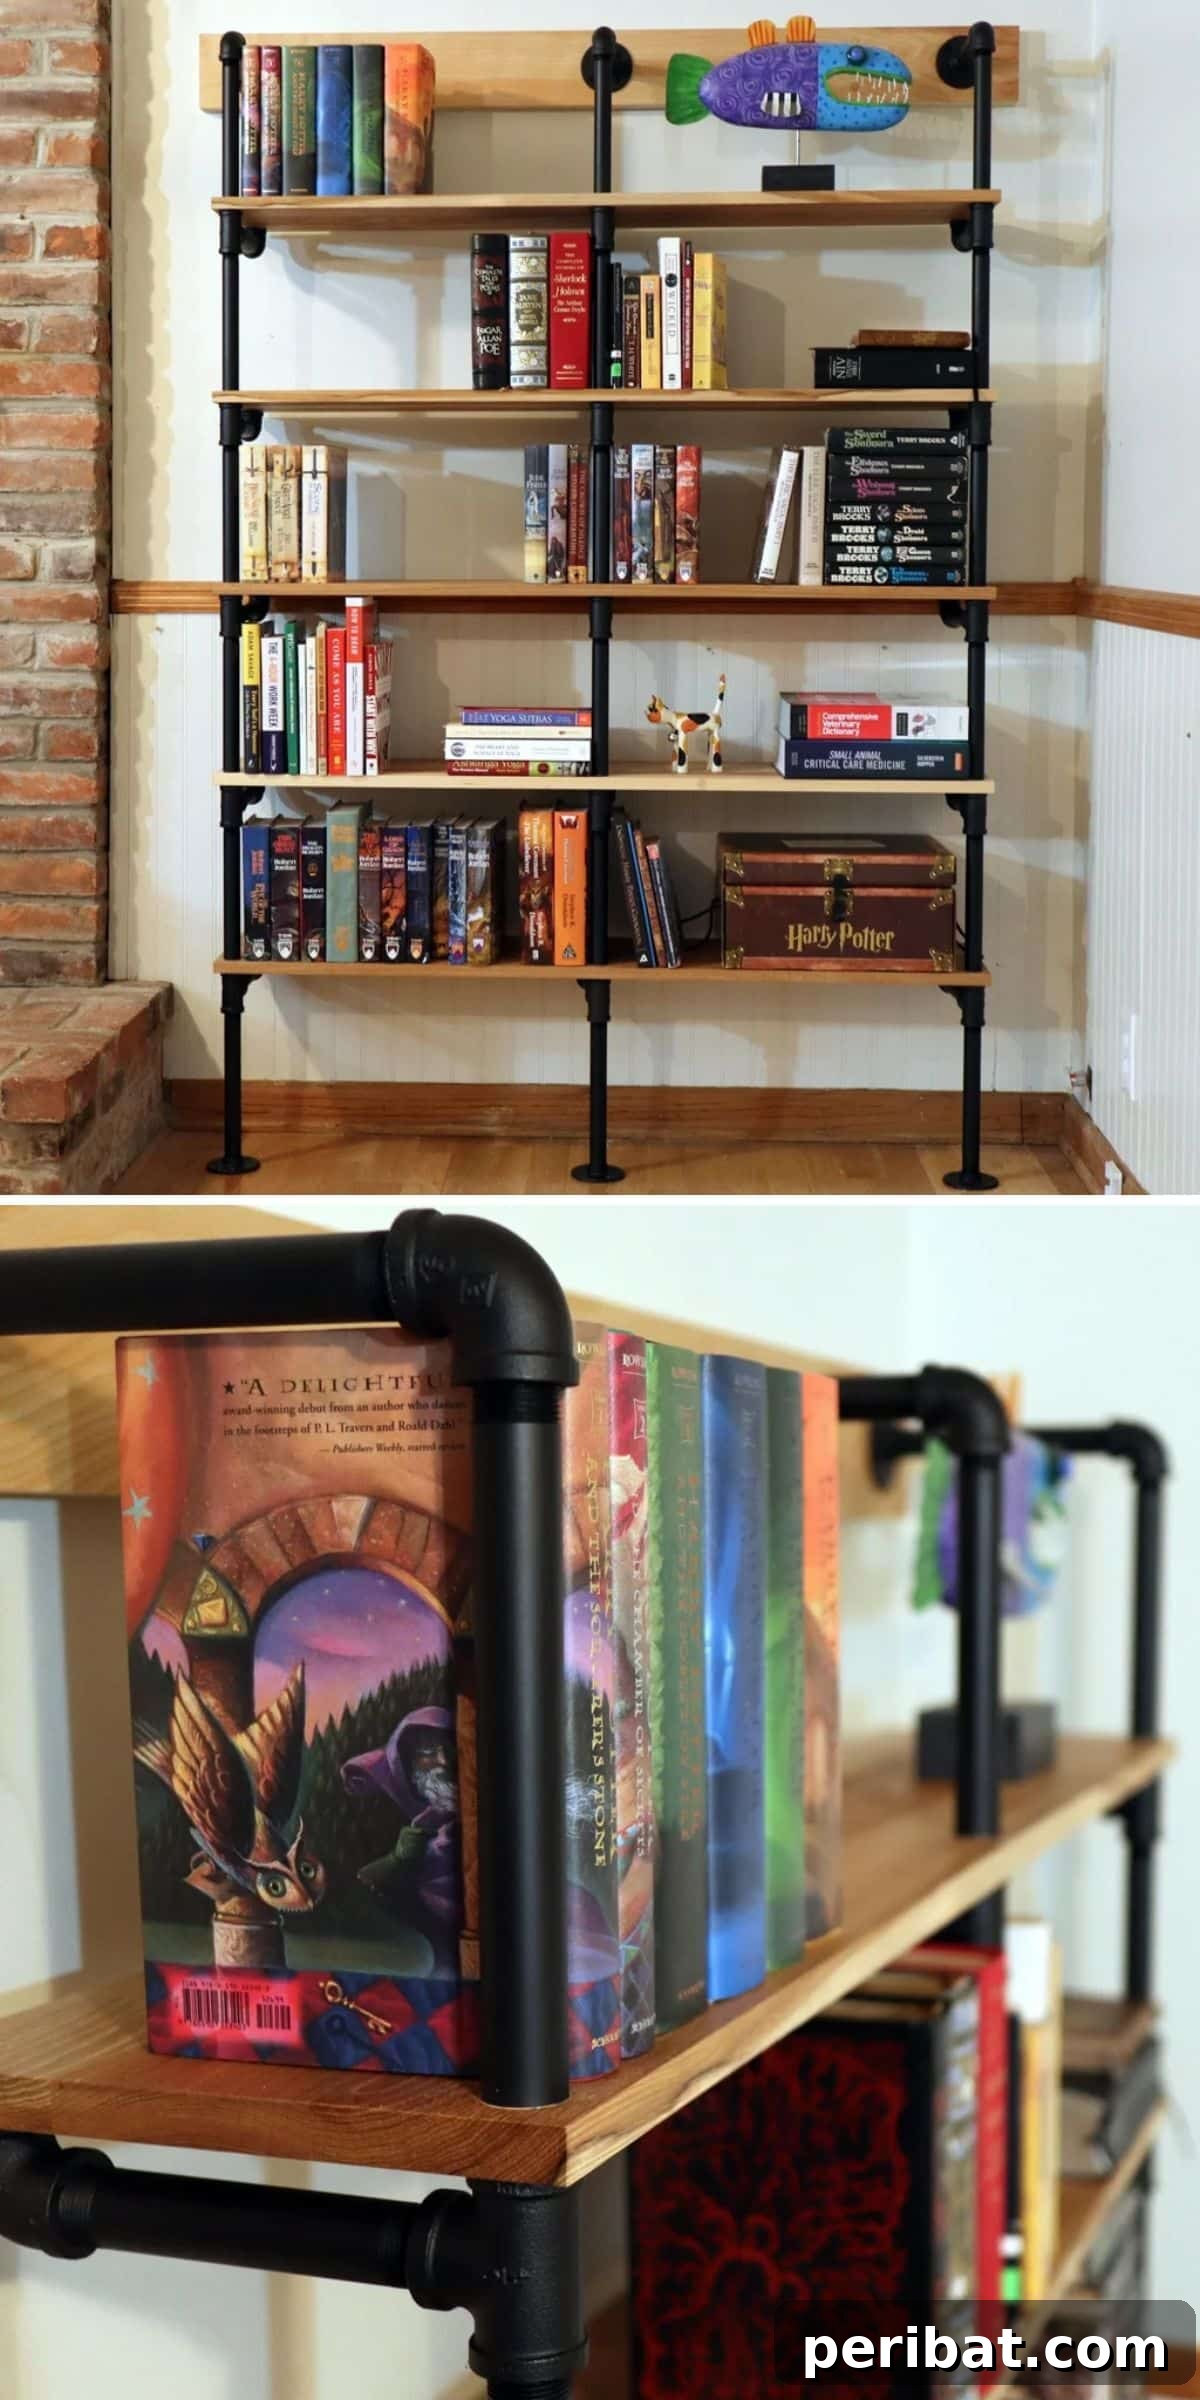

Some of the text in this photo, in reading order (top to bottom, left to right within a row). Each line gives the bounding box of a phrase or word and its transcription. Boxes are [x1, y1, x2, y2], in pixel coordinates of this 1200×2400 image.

[553, 274, 586, 284] Sherlock
[552, 286, 586, 298] Holmes
[667, 291, 677, 337] WICKED
[477, 327, 502, 336] EDGAR
[477, 335, 502, 343] ALLAN
[480, 343, 500, 355] POE
[836, 357, 846, 380] NIV
[844, 438, 894, 449] Shannara
[833, 513, 871, 521] BROOKS
[841, 526, 876, 534] TERRY
[832, 534, 875, 542] BROOKS
[846, 546, 880, 554] TERRY
[837, 554, 879, 562] BROOKS
[839, 567, 873, 575] TERRY
[831, 575, 873, 583] BROOKS
[269, 642, 278, 655] THE
[332, 639, 340, 734] COME AS YOU ARE
[269, 686, 278, 706] WORK
[269, 708, 278, 728] WEEK
[490, 713, 517, 723] YOGA
[519, 713, 553, 724] SUTRAS
[822, 712, 879, 722] Comprehensive
[367, 695, 376, 755] START WITH WHY
[823, 721, 861, 730] Veterinary
[823, 728, 861, 737] Dictionary
[830, 750, 882, 760] SMALL ANIMAL
[804, 759, 906, 771] CRITICAL CARE MEDICINE
[786, 922, 896, 953] Harry Potter
[280, 1375, 443, 1394] DELIGHTFU
[224, 1404, 296, 1418] award-winning
[298, 1402, 326, 1414] debut
[330, 1402, 354, 1413] from
[372, 1400, 404, 1411] author
[408, 1399, 430, 1410] who
[224, 1427, 233, 1437] in
[237, 1425, 252, 1436] the
[255, 1424, 298, 1438] footsteps
[301, 1423, 310, 1433] of
[315, 1423, 322, 1433] P.
[326, 1423, 336, 1433] L.
[340, 1422, 374, 1433] Travers
[376, 1421, 395, 1432] and
[399, 1420, 427, 1431] Roald
[333, 1442, 373, 1454] Publishers
[587, 1457, 599, 1521] AND
[588, 1532, 602, 1596] THE
[632, 1589, 644, 1718] CHAMBER
[636, 1725, 644, 1756] OF
[635, 1767, 645, 1857] SECRETS
[593, 1773, 607, 1867] STONE
